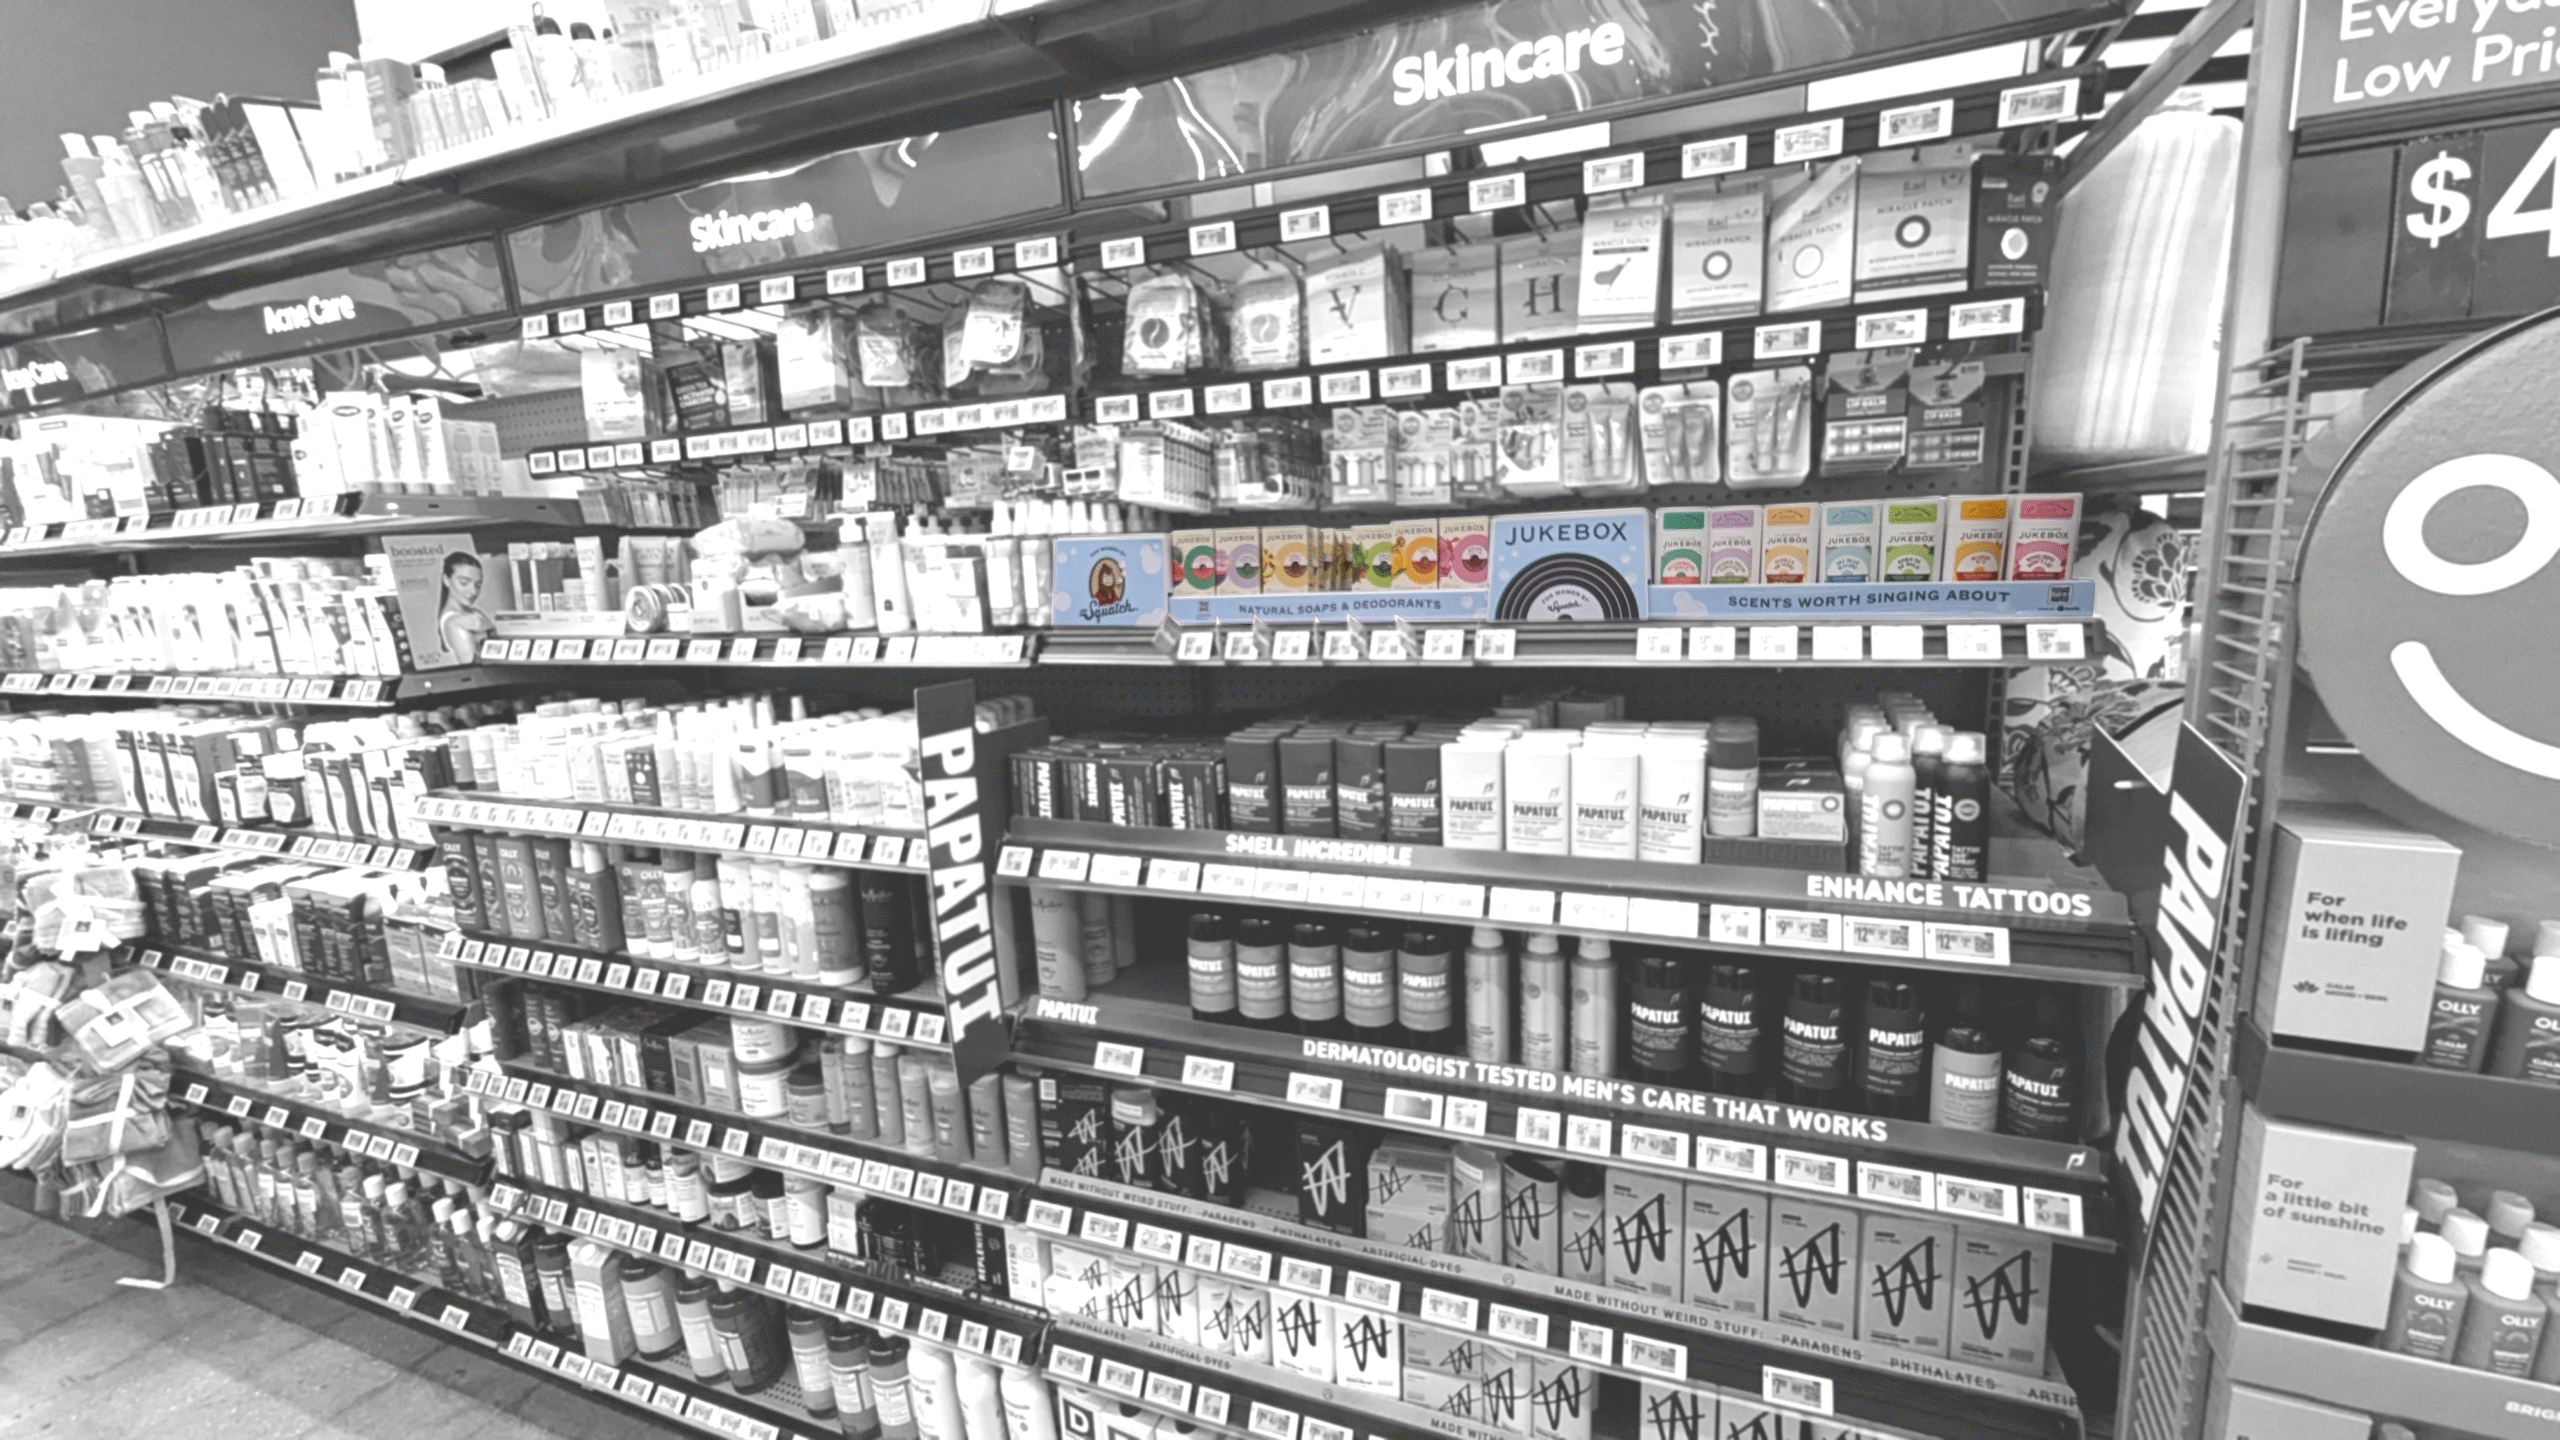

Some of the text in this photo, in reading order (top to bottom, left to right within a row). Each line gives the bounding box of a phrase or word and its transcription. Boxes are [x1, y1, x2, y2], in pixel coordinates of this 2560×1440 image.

[1392, 22, 1625, 105] Skincare
[2333, 27, 2560, 103] Low Pri
[690, 202, 815, 252] Skincare
[263, 295, 356, 334] Acne Care
[28, 361, 68, 384] Care
[1395, 527, 1433, 536] JUKEBOX
[1443, 524, 1485, 534] JUKEBOX
[1505, 522, 1627, 546] JUKEBOX
[1889, 535, 1934, 543] JUKEBOX
[1960, 532, 2003, 540] JUKEBOX
[2019, 531, 2069, 540] JUKEBOX
[1713, 539, 1751, 548] JUKEBOX
[1768, 537, 1808, 545] JUKEBOX
[1828, 536, 1871, 545] JUKEBOX
[1239, 599, 1441, 615] NATURAL SOAPS & DEODORANTS
[1729, 590, 2010, 609] SCENTS WORTH SINGING ABOUT
[1082, 599, 1138, 623] Squatch
[1230, 785, 1266, 800] PAPATUI
[1286, 787, 1327, 801] PAPATUI
[1392, 797, 1436, 810] PAPATUI
[1450, 799, 1493, 812] PAPATUI
[1514, 804, 1558, 818] PAPATUI
[1578, 806, 1625, 821] PAPATUI
[1641, 808, 1687, 824] PAPATUI
[1226, 834, 1413, 866] SMELL INCREDIBLE
[640, 870, 664, 880] OLLY
[921, 727, 1001, 1043] PAPATUI
[1807, 875, 2092, 917] ENHANCE TATTOOS
[2307, 891, 2346, 907] For
[2304, 910, 2408, 931] when life
[2302, 926, 2384, 948] is lifing
[1403, 972, 1447, 988] PAPATUI
[1037, 998, 1099, 1025] PAPATUI
[1631, 1001, 1681, 1024] PAPATUI
[1700, 1001, 1751, 1025] PAPATUI
[2115, 790, 2227, 1228] PAPATUI
[2438, 1000, 2481, 1014] OLLY
[1783, 1015, 1838, 1041] PAPATUI
[1869, 1027, 1924, 1047] PAPATUI
[1303, 1039, 1888, 1142] DERMATOLOGIST TESTED MEN'S CARE THAT WORKS
[1944, 1072, 1998, 1092] PAPATUI
[2006, 1069, 2061, 1098] PAPATUI
[2267, 1173, 2304, 1190] For
[2265, 1190, 2369, 1218] a little bit
[1049, 1175, 1463, 1274] MADE WITHOUT WEIRD STUFF: PARABENS PHTHALATES ARTIFICIAL DYES
[2263, 1204, 2385, 1236] of sunshine
[974, 1222, 988, 1282] REPLENISH
[1008, 1243, 1019, 1285] DEFEND
[2414, 1294, 2455, 1310] OLLY
[2501, 1314, 2540, 1328] OLLY
[1068, 1317, 1231, 1370] PHTHALATES ARTIFICIAL DYES
[1554, 1284, 1592, 1304] MADE
[1596, 1292, 1660, 1318] WITHOUT
[1663, 1307, 1708, 1328] WEIRD
[1714, 1319, 1765, 1340] STUFF:
[1780, 1333, 1863, 1362] PARABENS
[1889, 1357, 1997, 1391] PHTHALATES
[1431, 1418, 1464, 1434] MADE
